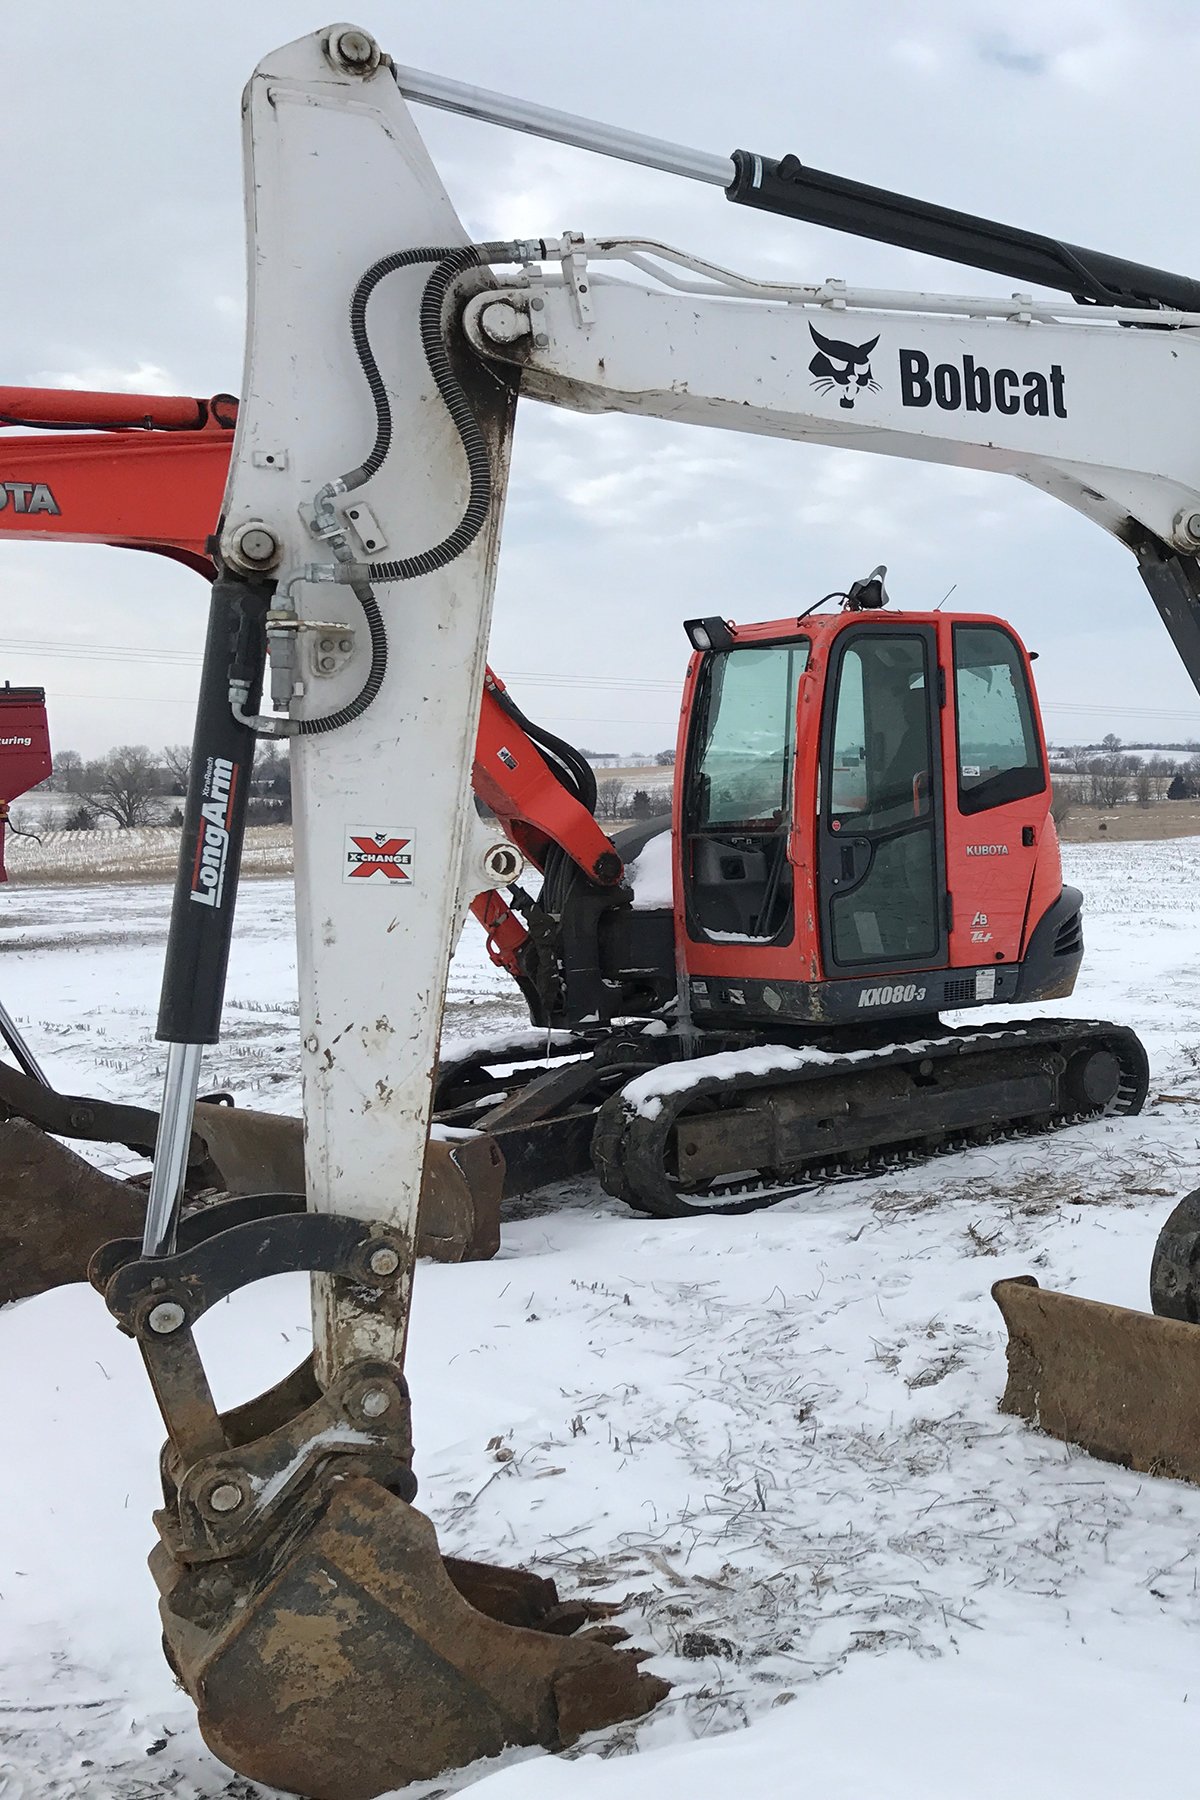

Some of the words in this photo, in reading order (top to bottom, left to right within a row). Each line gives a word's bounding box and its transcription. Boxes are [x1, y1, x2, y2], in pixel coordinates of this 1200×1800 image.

[899, 349, 1067, 418] Bobcat
[0, 736, 32, 746] uring
[202, 756, 214, 797] XtraReach
[190, 757, 233, 908] LongArm
[349, 853, 409, 864] X-CHANGE
[966, 845, 1009, 855] KUBOTA
[858, 984, 926, 1008] KX080-3
